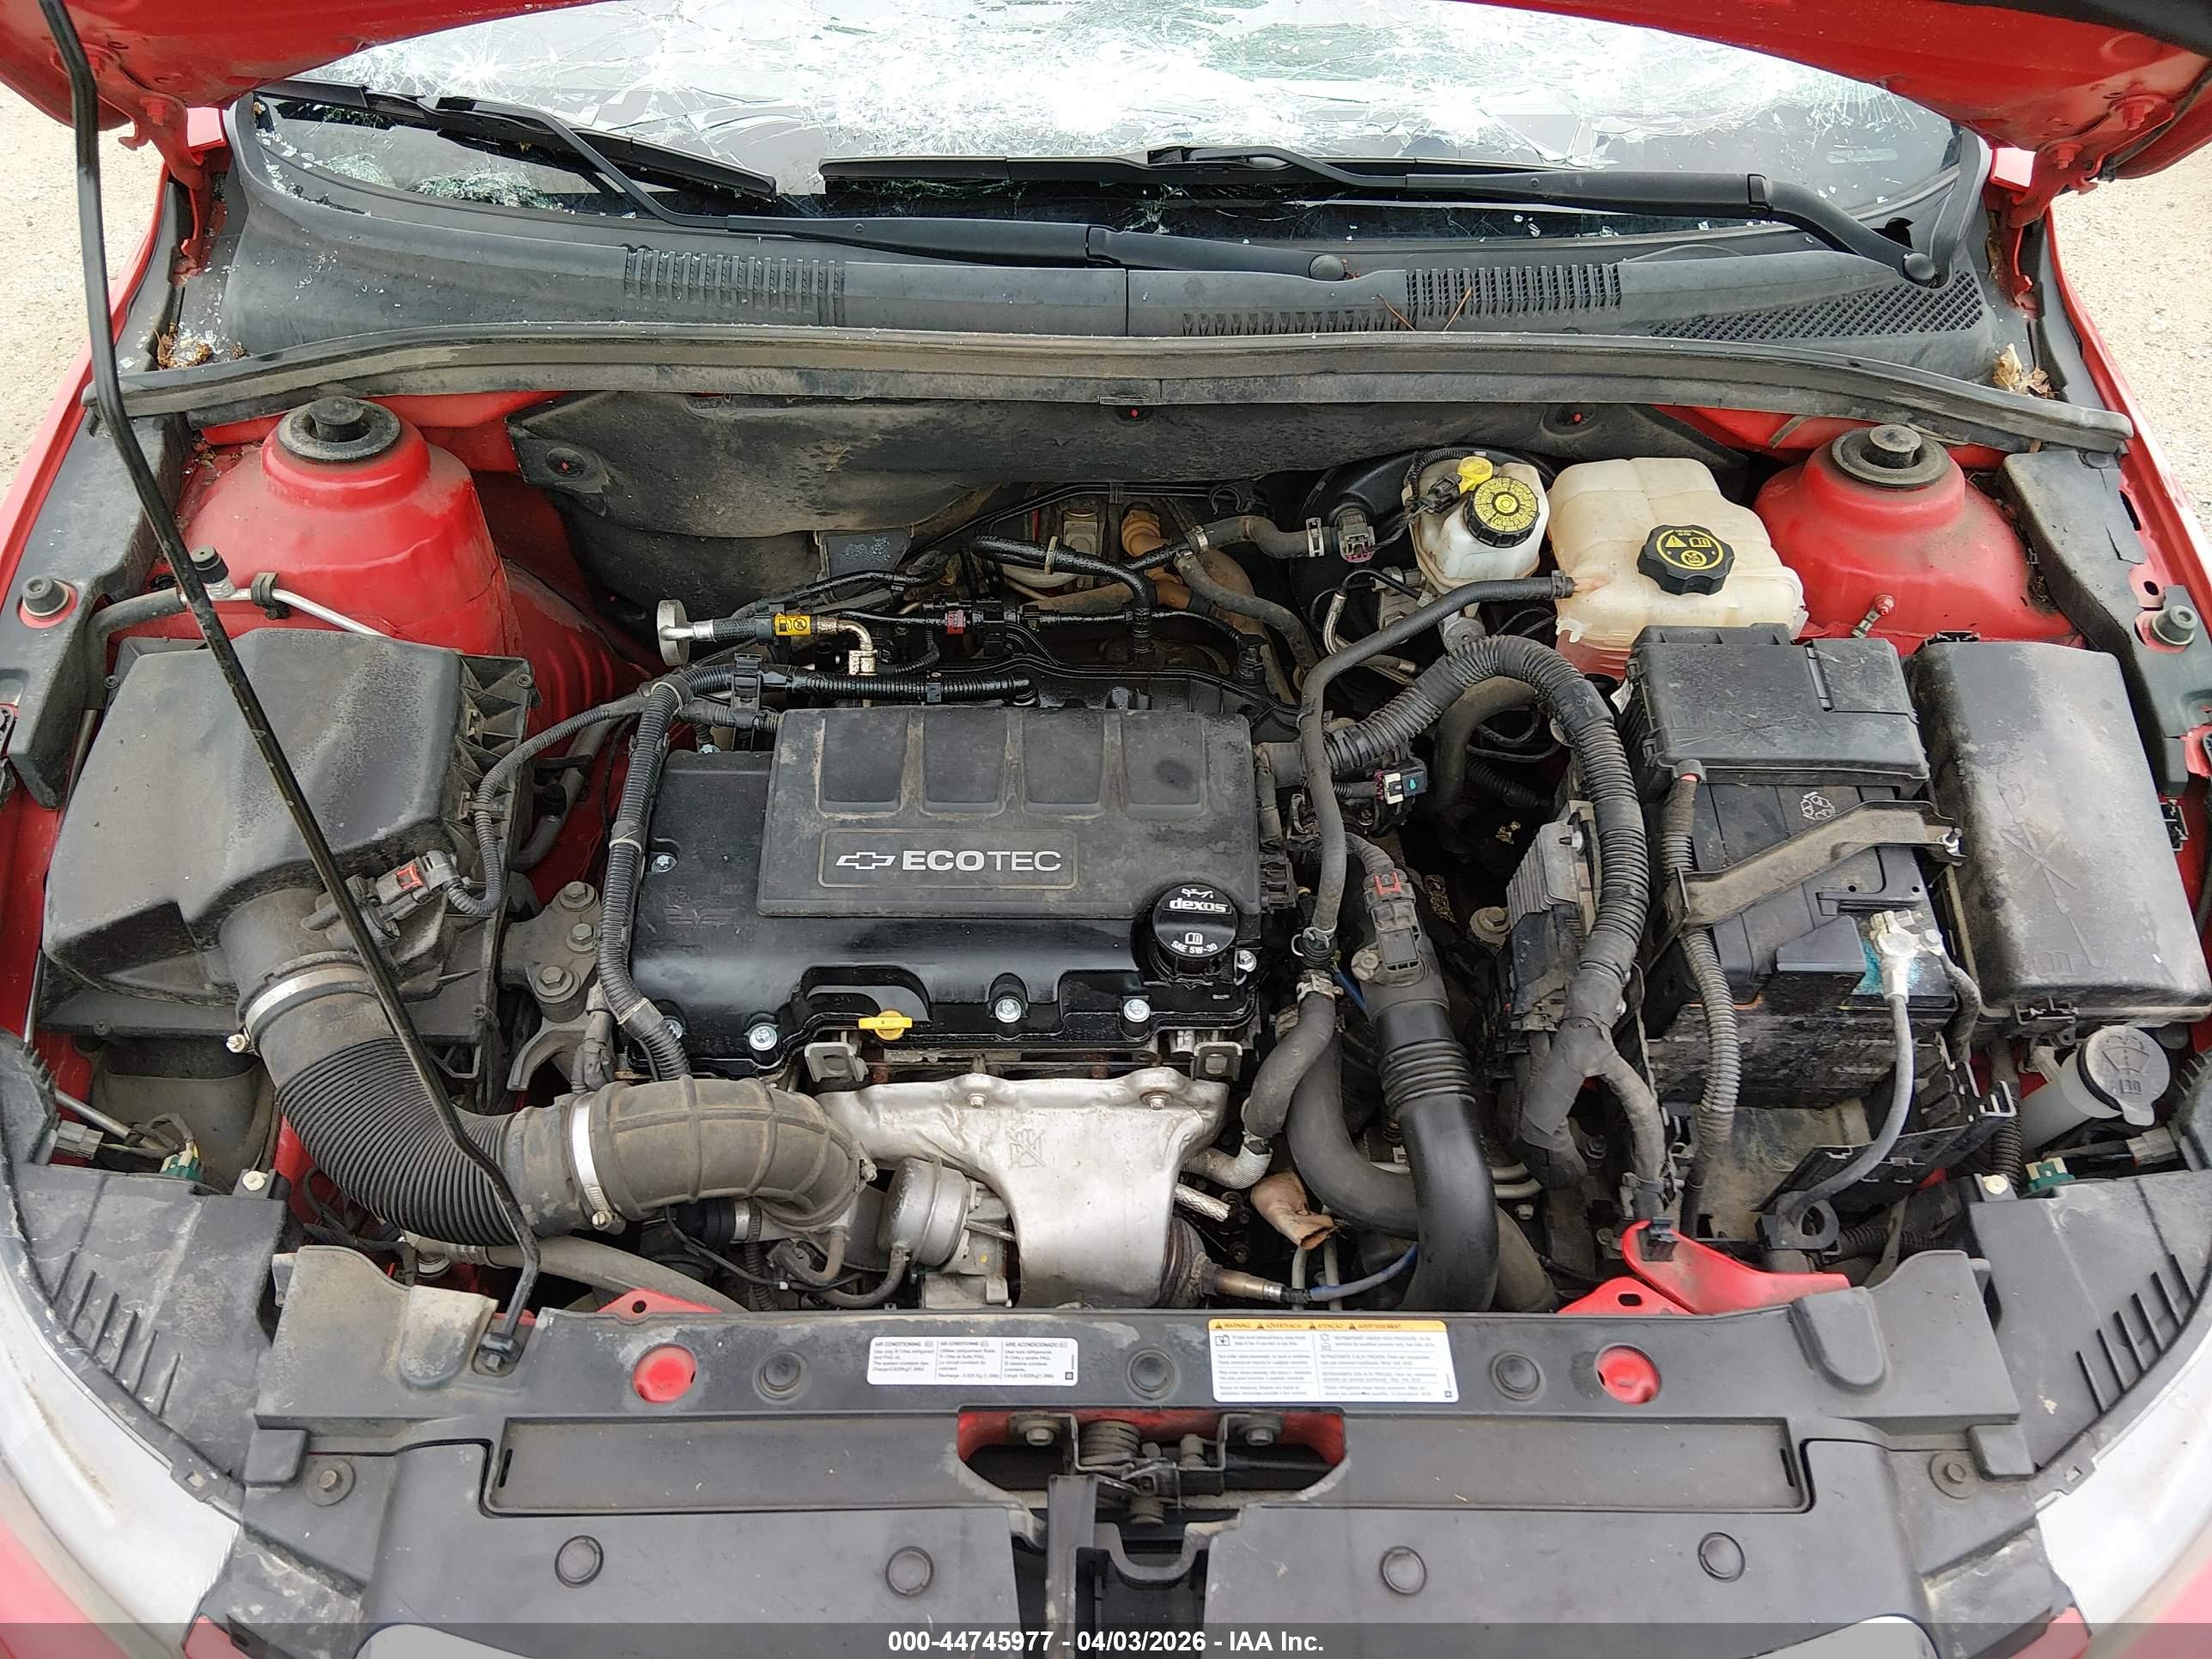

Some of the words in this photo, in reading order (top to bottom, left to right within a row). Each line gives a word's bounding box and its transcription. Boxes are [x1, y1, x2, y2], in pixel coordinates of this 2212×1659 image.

[902, 850, 1061, 872] ECOTEC
[1169, 897, 1228, 913] dexos
[1170, 940, 1188, 953] SAE
[1189, 942, 1218, 954] 5W-30
